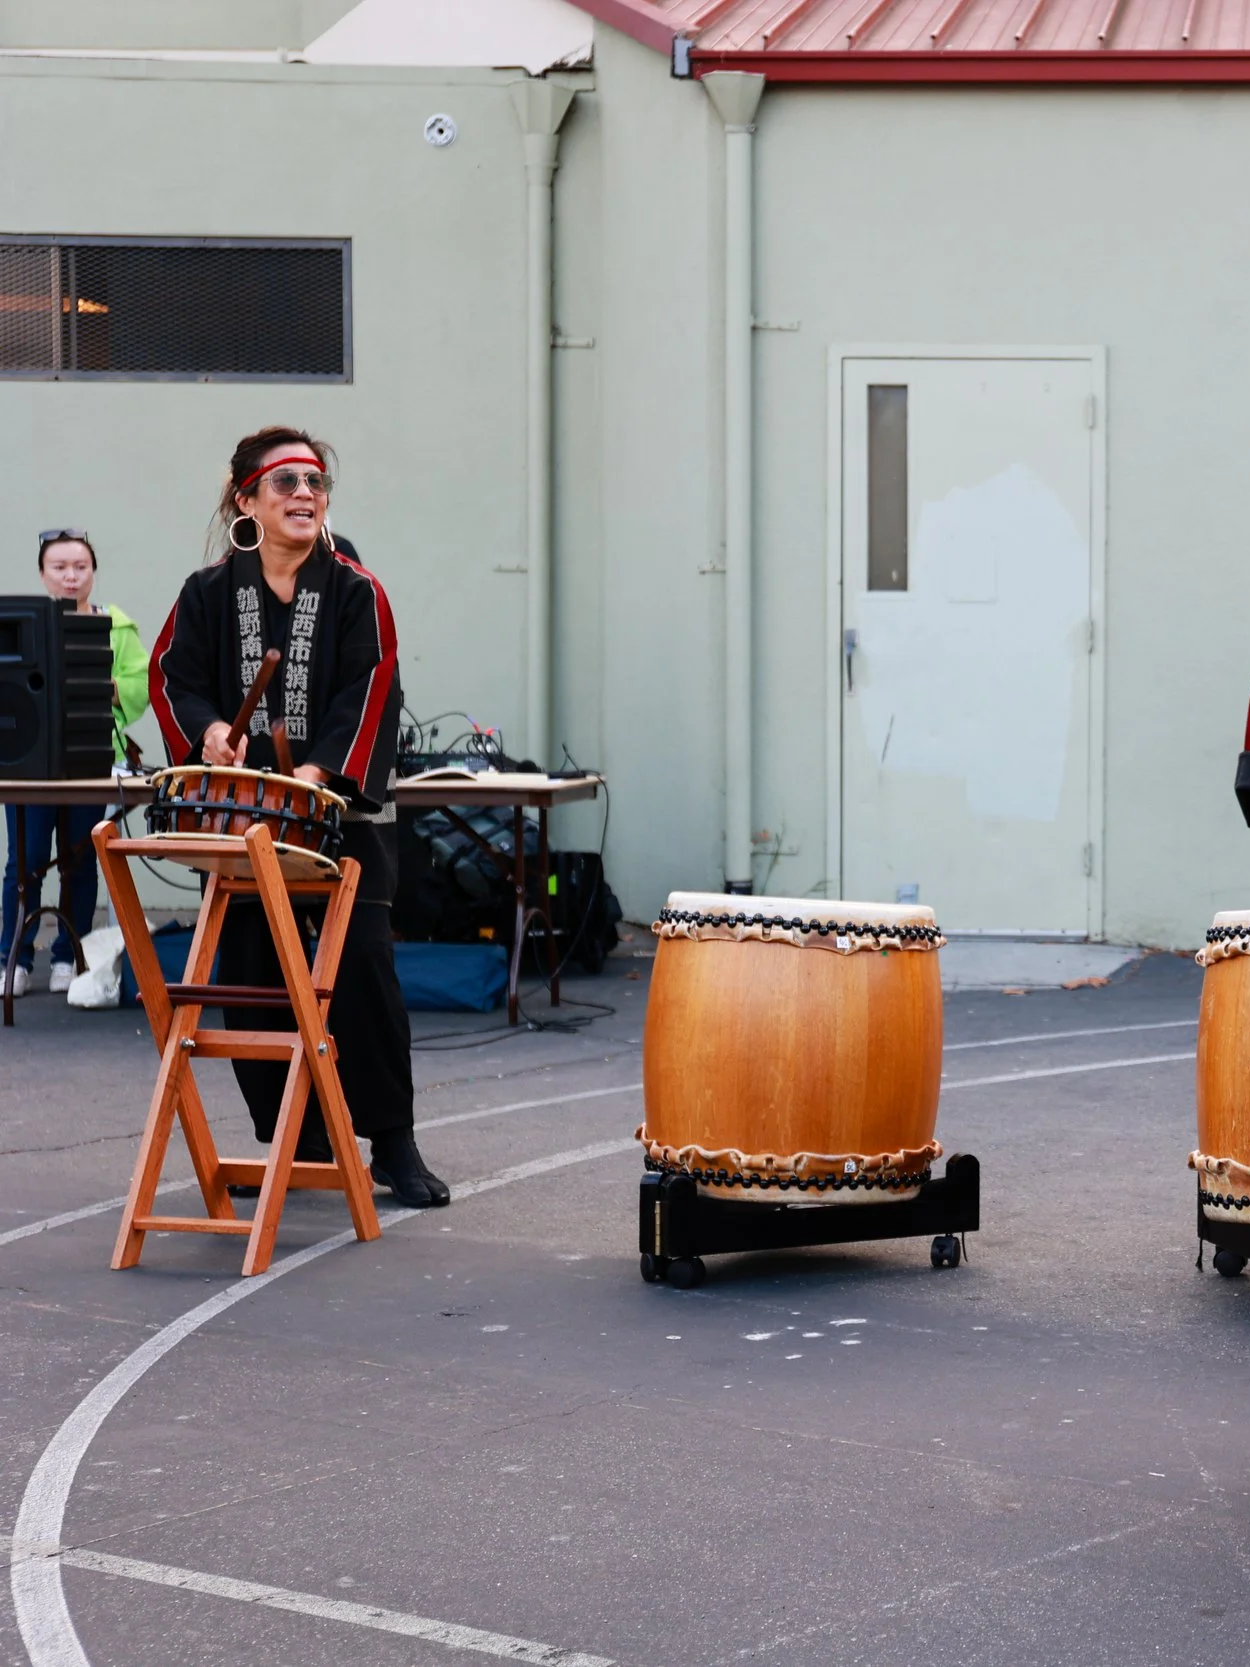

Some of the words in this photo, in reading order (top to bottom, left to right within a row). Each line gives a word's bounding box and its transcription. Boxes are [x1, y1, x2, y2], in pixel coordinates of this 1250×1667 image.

[284, 588, 320, 742] 加西市消防団
